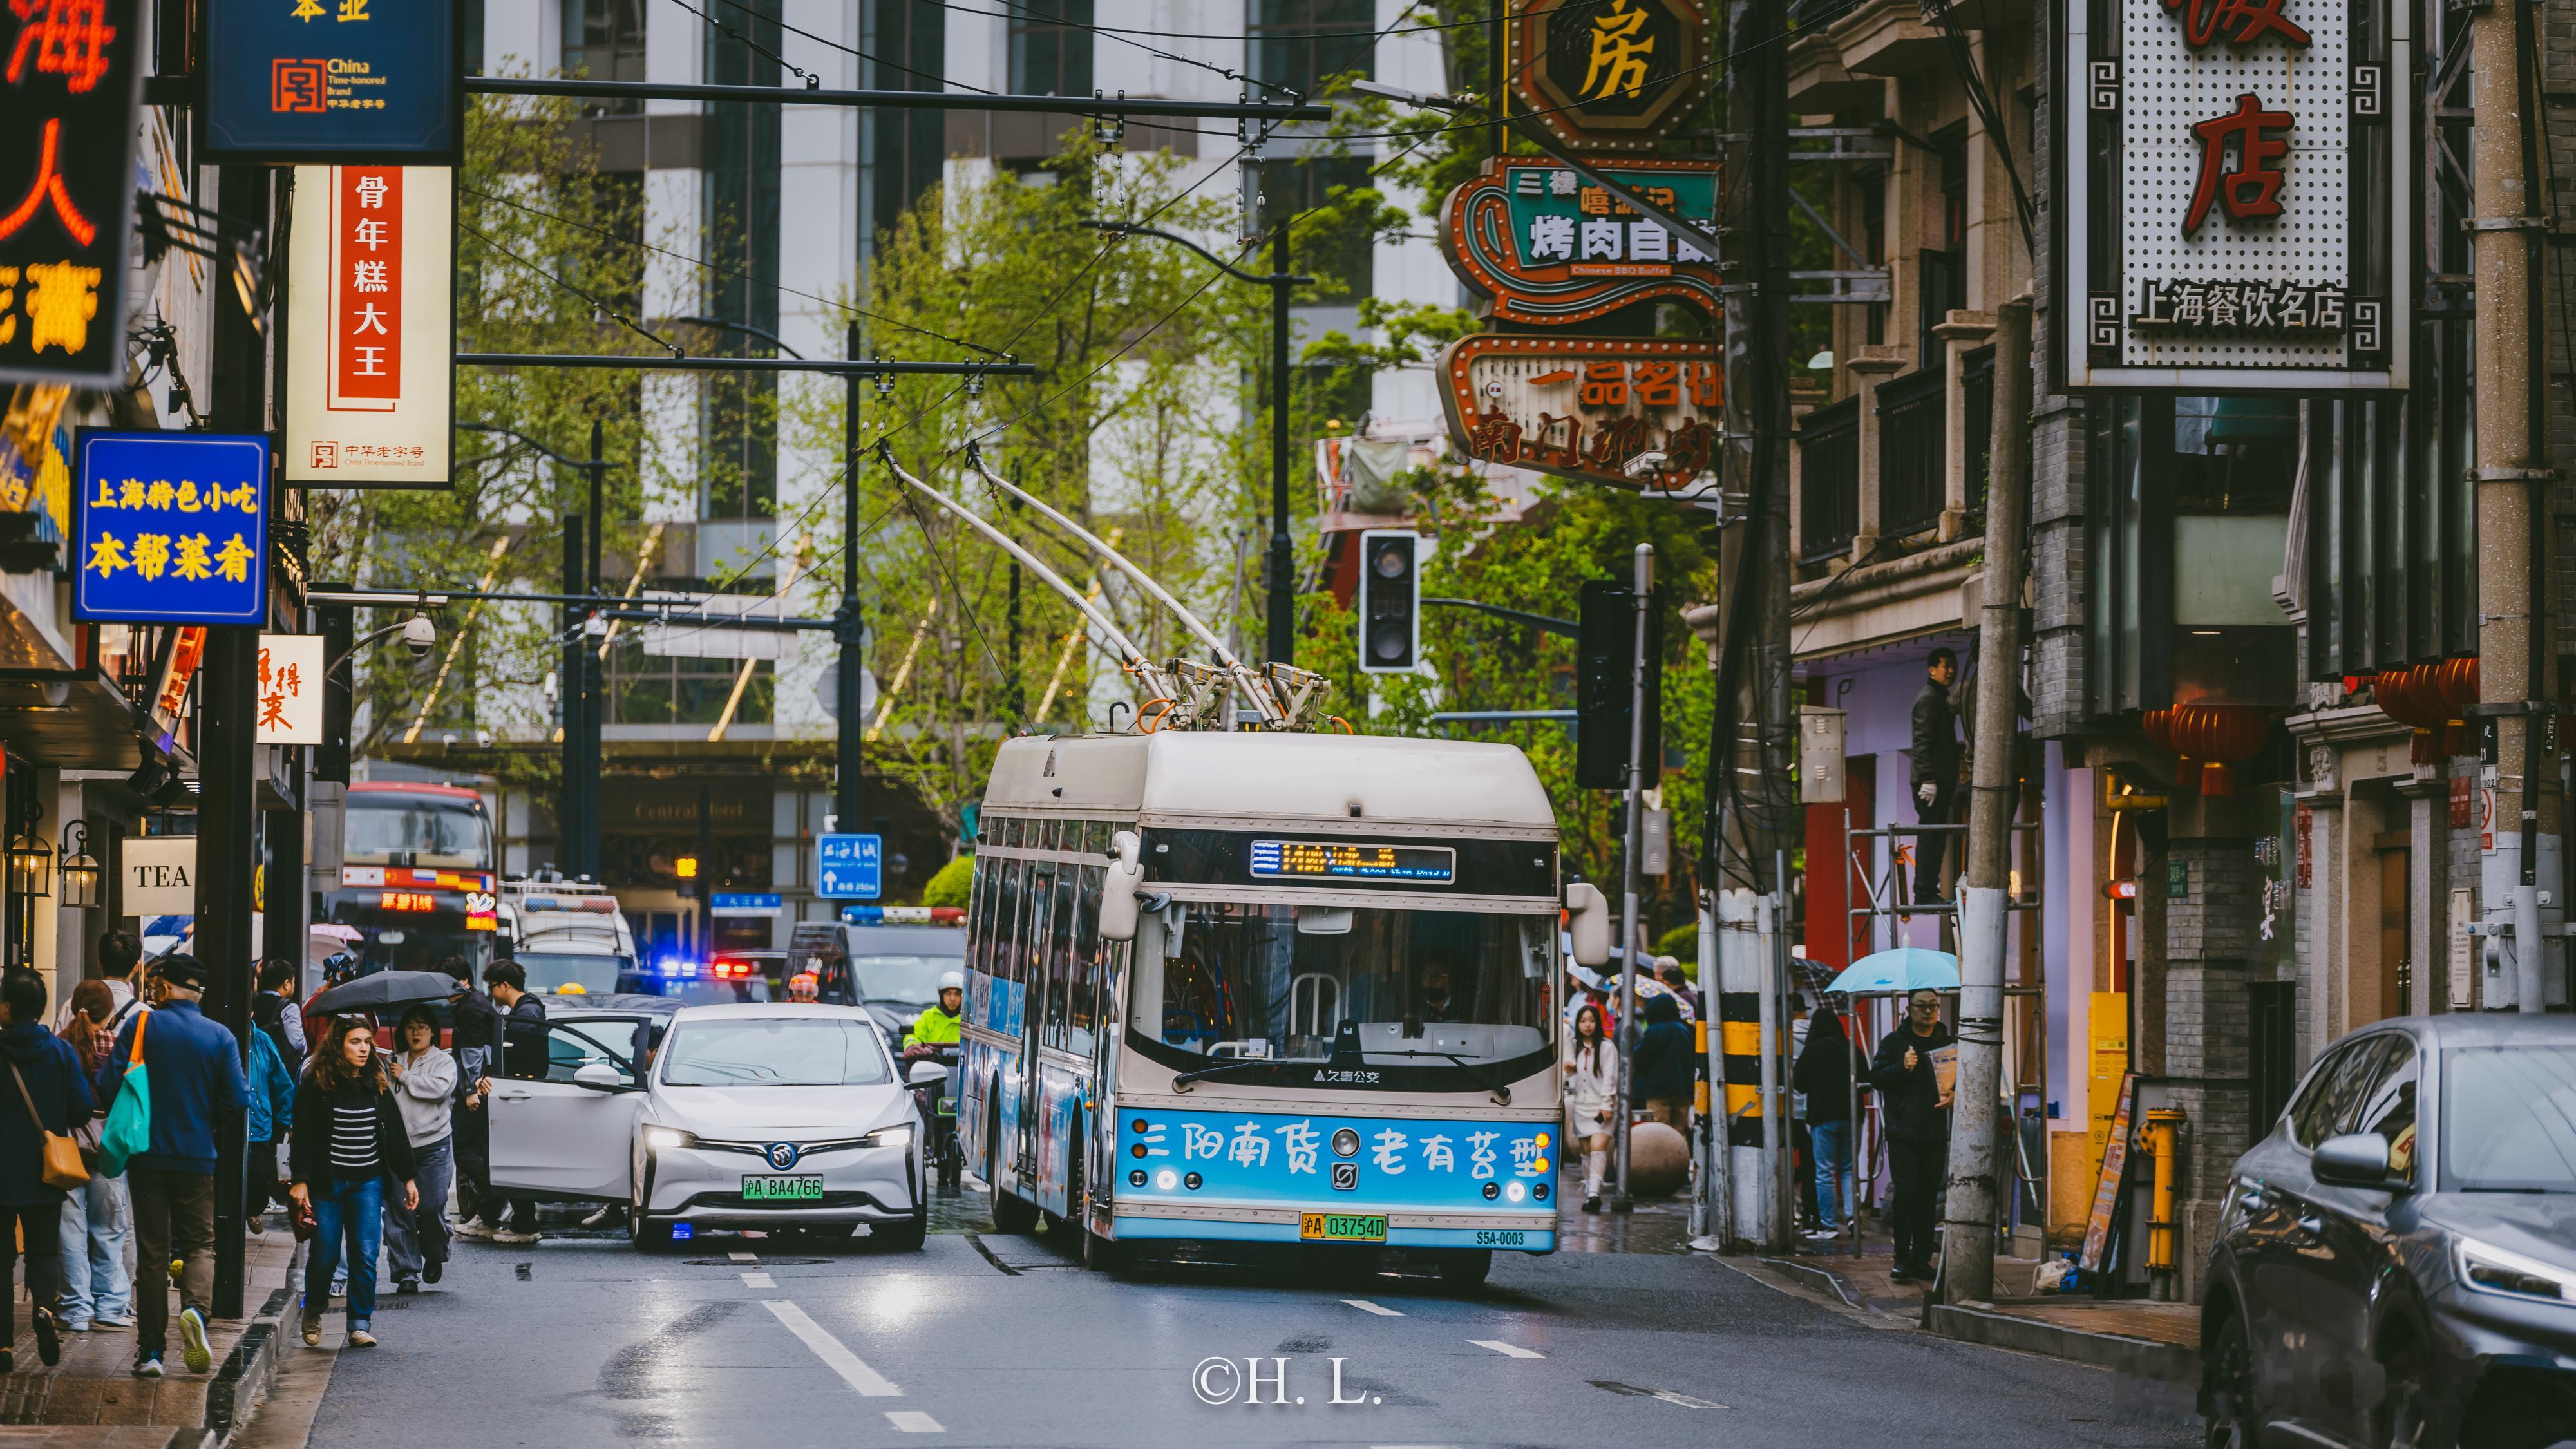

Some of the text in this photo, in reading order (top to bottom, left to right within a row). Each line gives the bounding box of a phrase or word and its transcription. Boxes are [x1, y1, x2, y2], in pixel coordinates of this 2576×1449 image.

[1579, 0, 1654, 99] 房
[327, 59, 370, 73] China
[328, 76, 386, 84] Time-honored
[327, 87, 352, 95] Brand
[327, 99, 386, 109] 中华老字号
[1572, 266, 1670, 276] Chinese BBQ Buffet
[2137, 285, 2345, 329] 上海餐饮名店
[345, 446, 424, 458] 中华老字号
[90, 478, 258, 513] 上海特色小吃
[86, 531, 256, 583] 本帮菜肴
[133, 865, 191, 887] TEA
[1327, 1069, 1380, 1083] 久事公交
[1143, 1120, 1320, 1175] 三阳南货
[769, 1179, 820, 1195] BA4766
[1304, 1217, 1384, 1236] 沪A 03754D
[1477, 1231, 1524, 1245] S5A-0003
